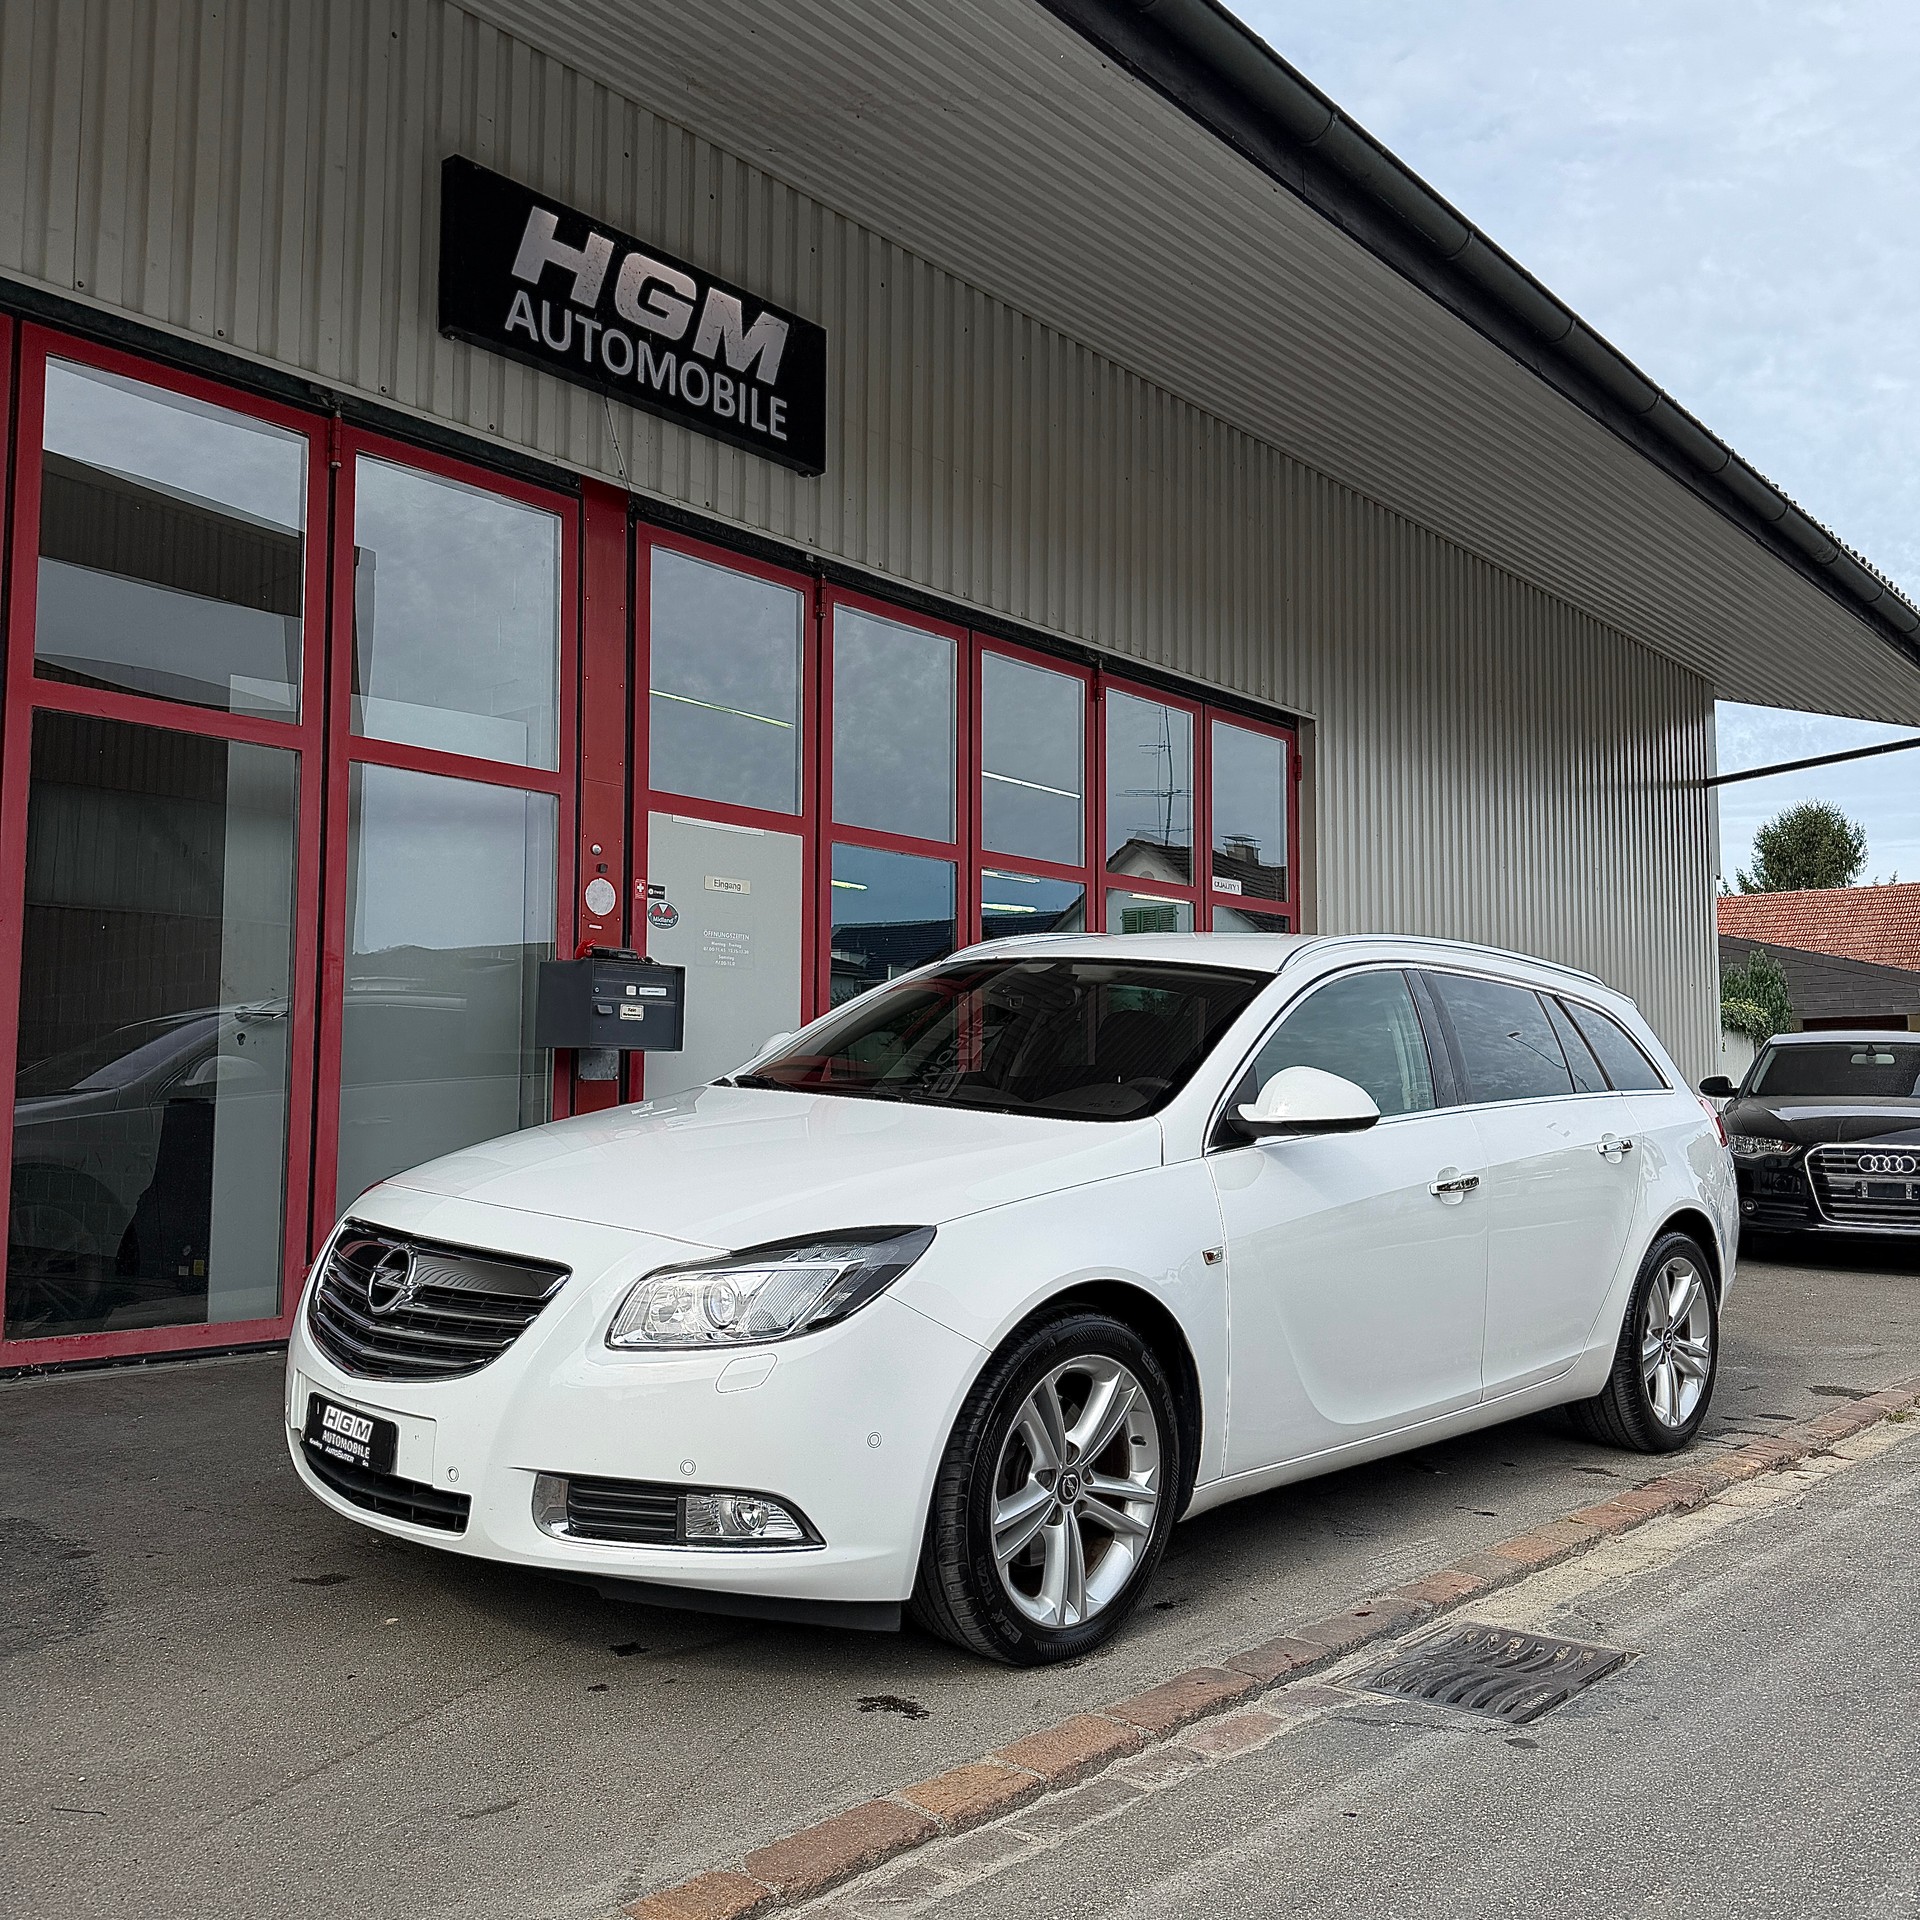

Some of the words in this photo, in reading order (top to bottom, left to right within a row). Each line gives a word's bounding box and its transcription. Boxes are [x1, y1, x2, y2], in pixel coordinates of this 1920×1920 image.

[511, 205, 790, 386] HGM
[504, 290, 788, 441] AUTOMOBILE
[713, 878, 742, 892] Eingang
[652, 915, 674, 924] Midland
[322, 1405, 374, 1443] HGM
[322, 1430, 371, 1459] AUTOMOBILE
